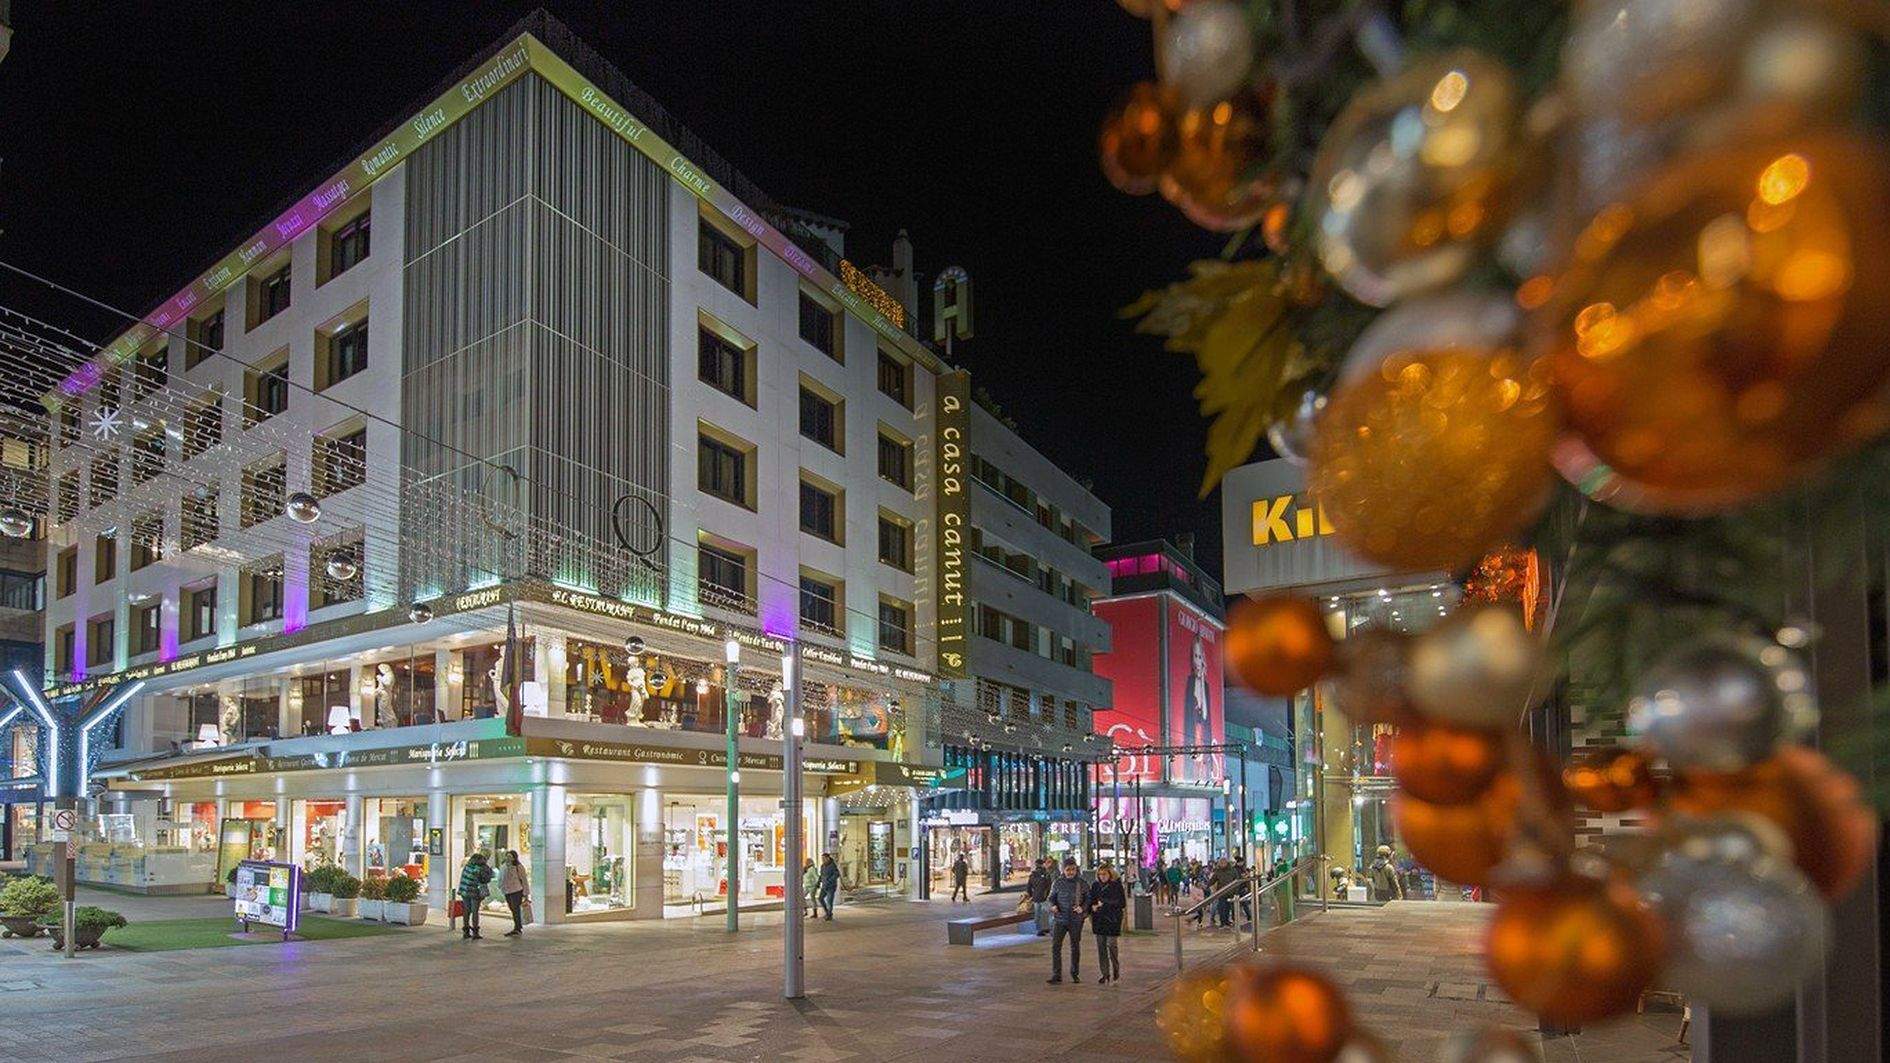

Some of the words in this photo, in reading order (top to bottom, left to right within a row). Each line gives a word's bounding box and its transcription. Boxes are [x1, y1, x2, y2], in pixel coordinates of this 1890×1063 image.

[413, 108, 446, 139] Silence
[581, 86, 648, 140] Beautiful
[669, 156, 711, 193] Charme
[943, 395, 960, 414] a
[943, 427, 960, 496] casa
[944, 513, 963, 606] canut
[582, 743, 631, 757] Restaurant
